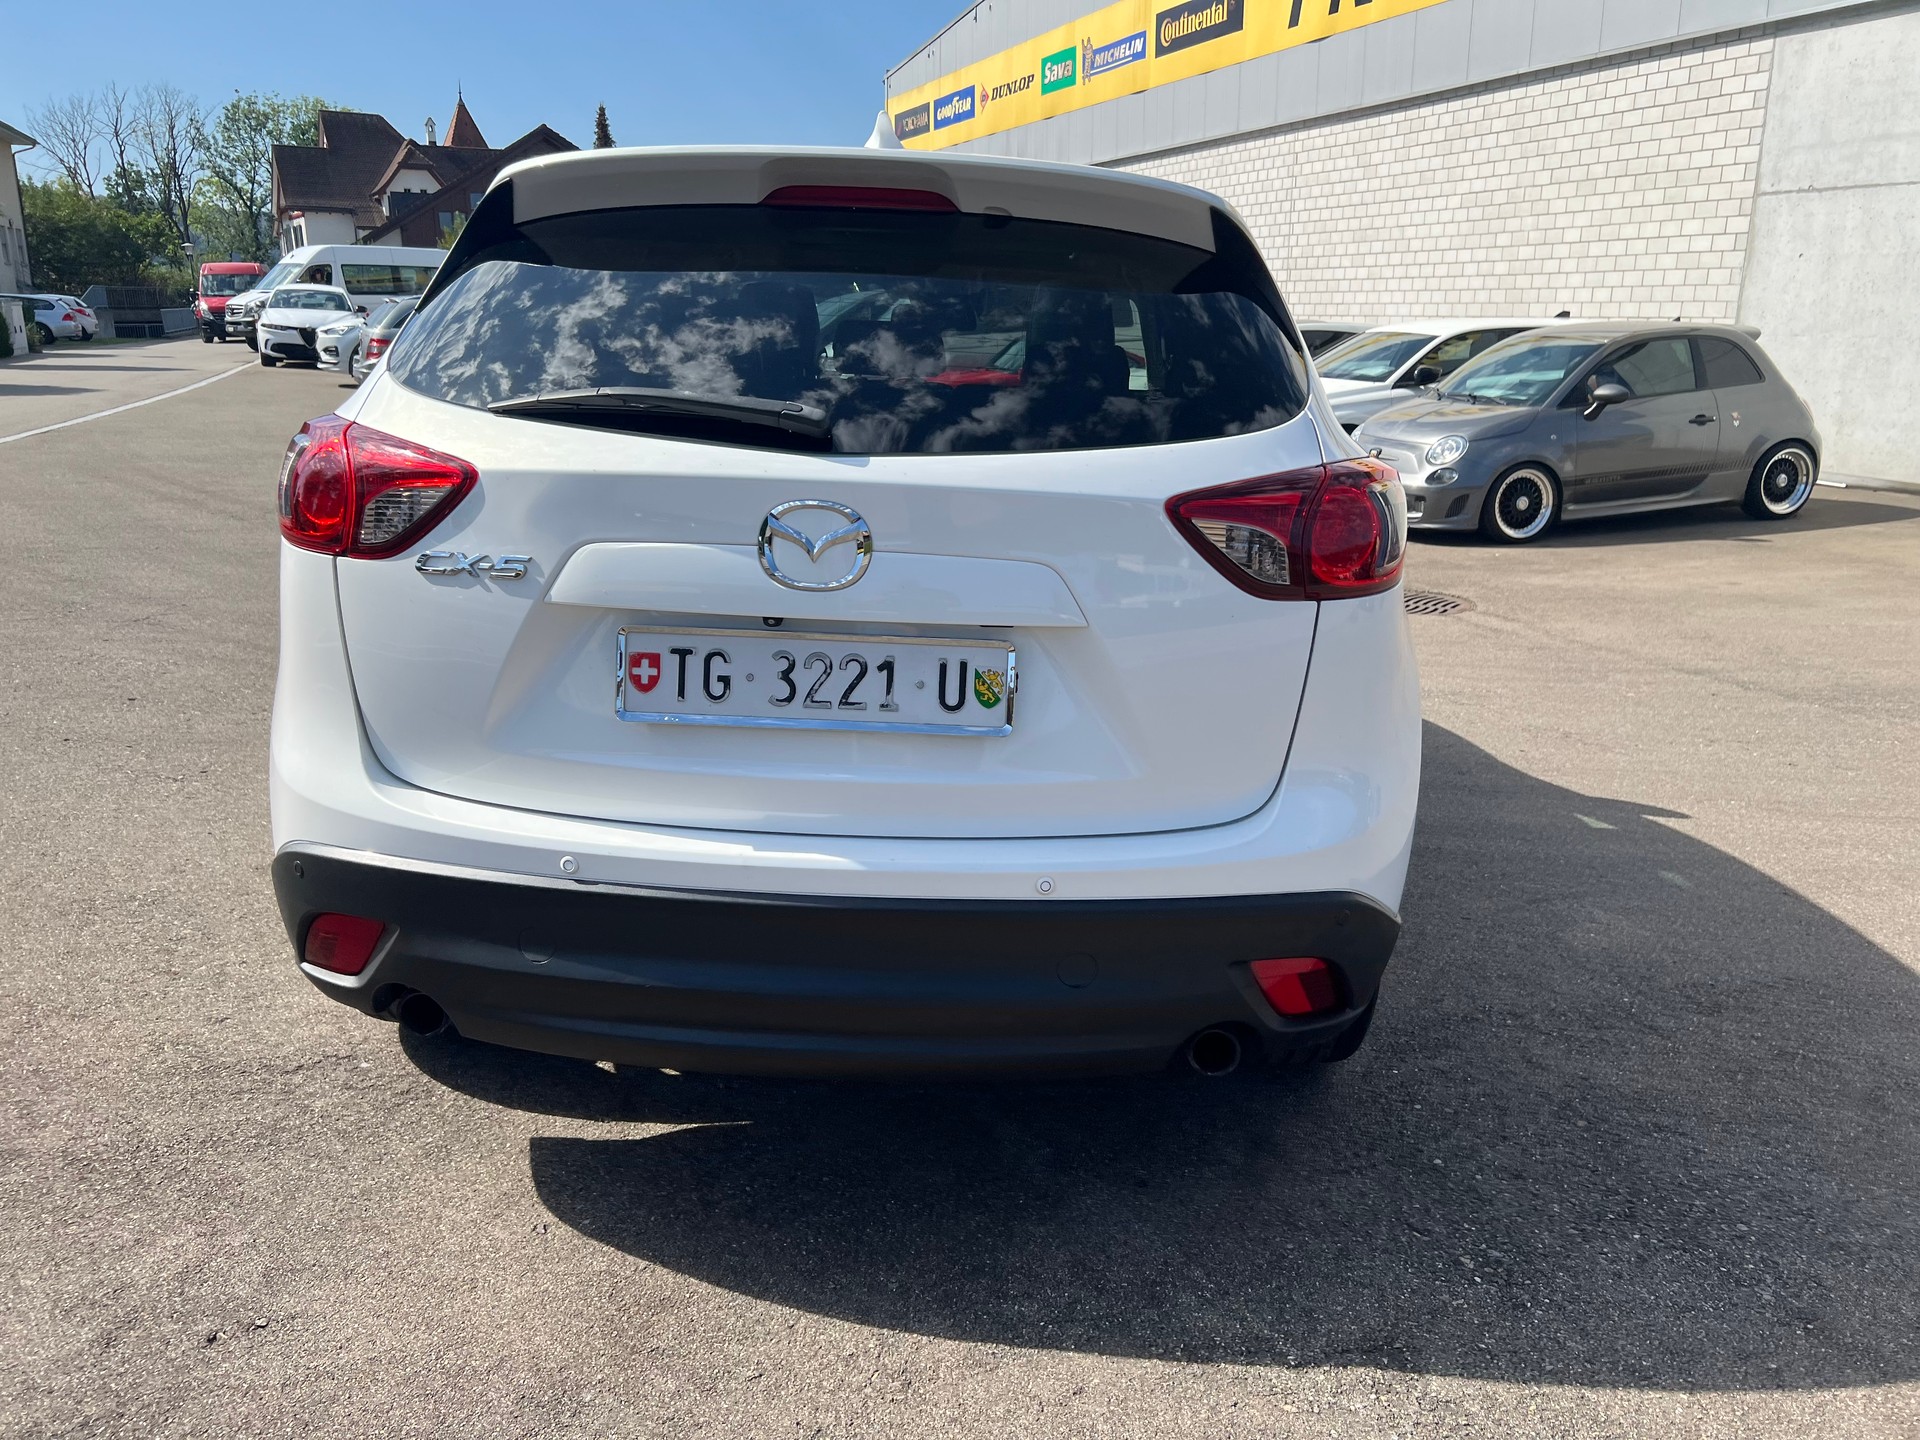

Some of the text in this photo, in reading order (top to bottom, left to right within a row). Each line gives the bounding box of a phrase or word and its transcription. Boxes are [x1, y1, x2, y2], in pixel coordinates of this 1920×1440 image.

[1160, 0, 1228, 47] Continental
[1094, 37, 1144, 68] MICHELIN
[1044, 60, 1073, 85] Sava
[991, 74, 1035, 101] DUNLOP
[937, 96, 972, 120] GOODYEAR
[415, 551, 533, 580] CX-5
[668, 646, 968, 714] TG 3221 U
